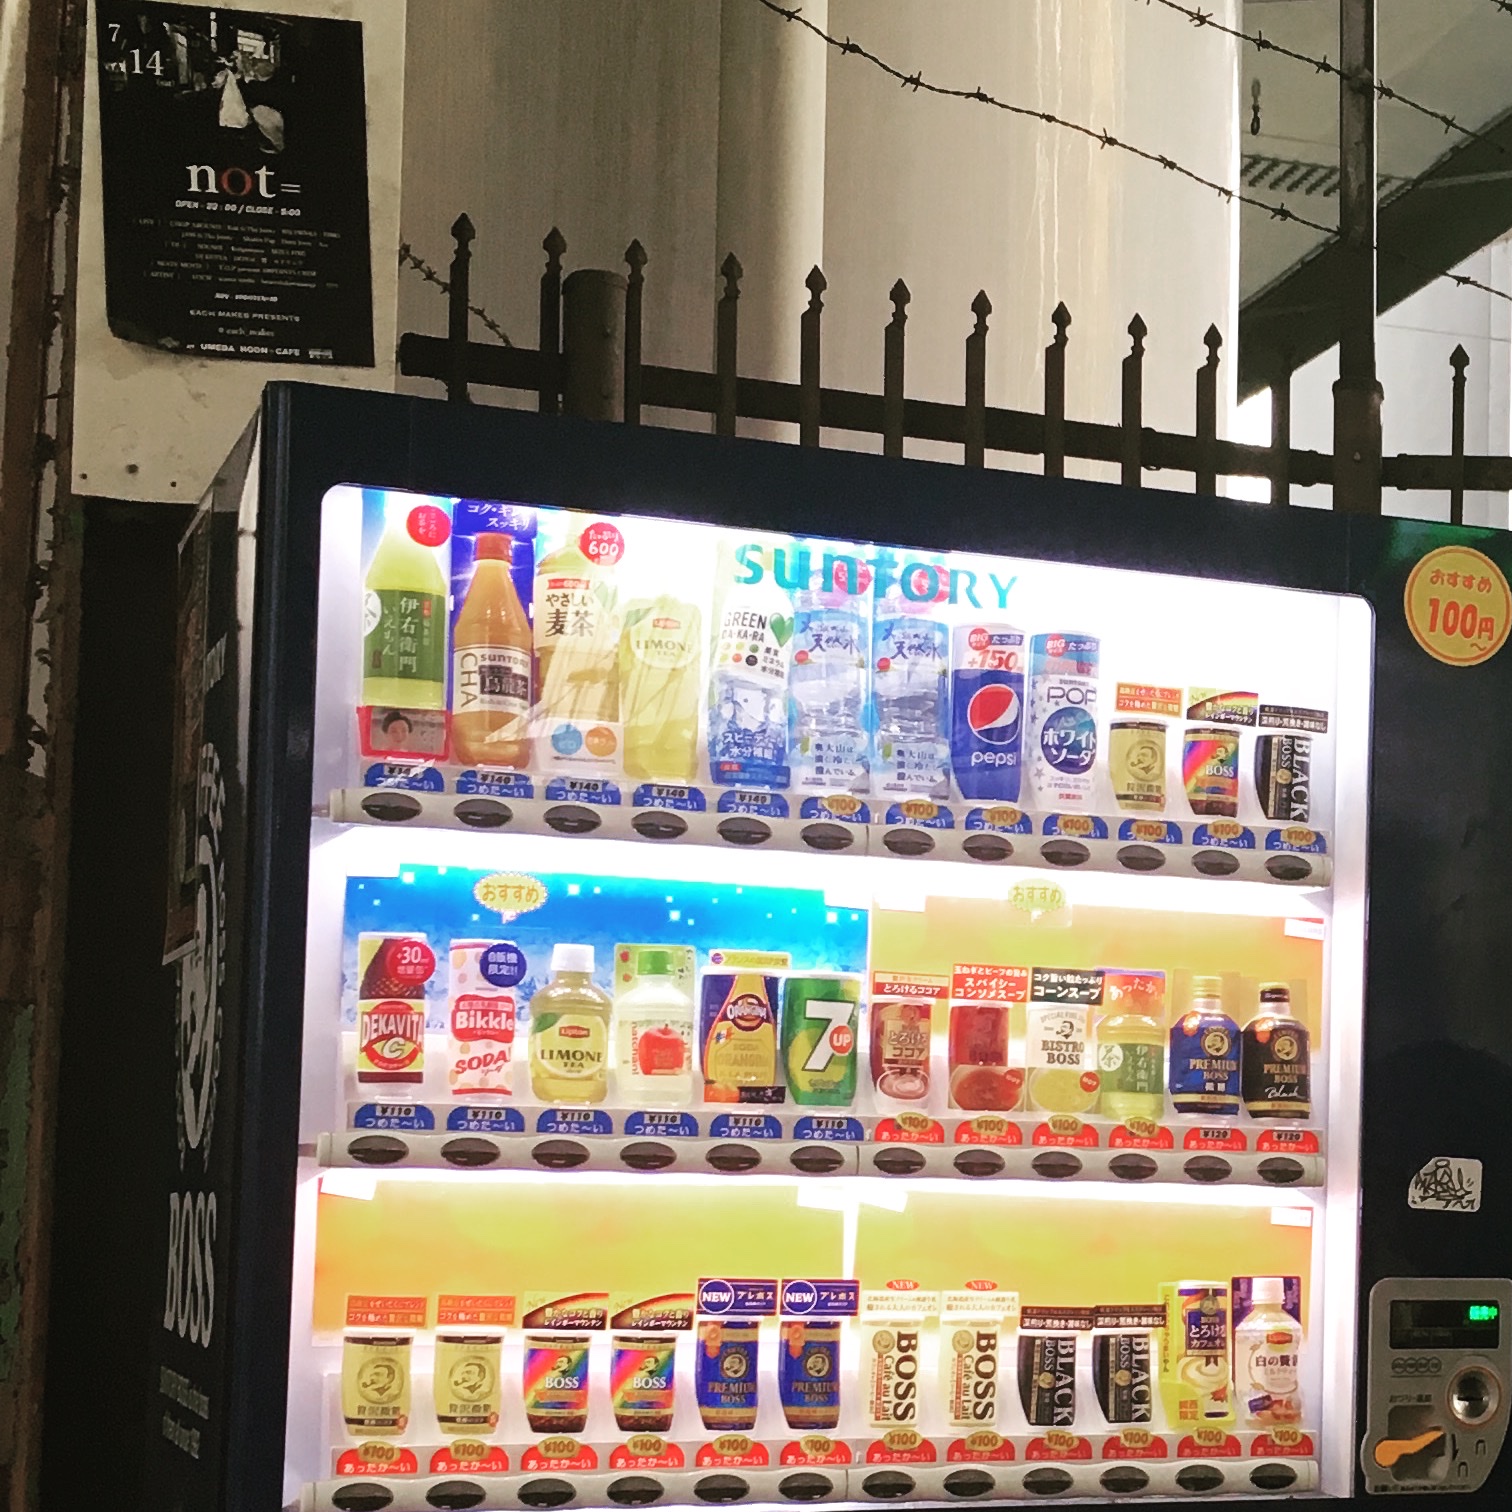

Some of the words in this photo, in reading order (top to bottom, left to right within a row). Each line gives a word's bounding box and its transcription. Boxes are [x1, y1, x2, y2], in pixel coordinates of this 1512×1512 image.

[130, 48, 164, 76] 14
[587, 541, 620, 557] 600
[734, 543, 1019, 610] SUNTORY
[1430, 568, 1493, 594] おすすめ
[545, 609, 595, 638] 麦茶
[399, 596, 420, 674] 伊右衛門
[459, 653, 479, 709] CHA
[1043, 727, 1097, 747] ホワイト
[970, 750, 1017, 767] pepsi
[1204, 763, 1235, 777] BOSS
[1289, 733, 1311, 822] BLACK
[482, 883, 540, 904] おすすめ
[883, 983, 942, 996] とろけるココア
[964, 977, 1016, 988] スパイシー
[954, 987, 1026, 1000] コンソメスープ
[1033, 985, 1101, 1000] コーンスープ
[455, 1010, 515, 1032] Bikkle
[801, 999, 855, 1073] 7
[831, 1032, 853, 1048] UP
[1040, 1039, 1084, 1054] BISTRO
[539, 1047, 604, 1064] LIMONE
[1046, 1051, 1081, 1065] BOSS
[891, 1279, 915, 1291] NEW
[970, 1279, 994, 1291] NEW
[701, 1290, 732, 1303] NEW
[784, 1291, 815, 1304] NEW
[1188, 1323, 1225, 1339] とろける
[544, 1376, 580, 1390] BOSS
[632, 1376, 667, 1390] BOSS
[892, 1330, 918, 1422] BOSS
[972, 1330, 998, 1422] BOSS
[1052, 1336, 1076, 1427] BLACK
[1129, 1335, 1152, 1425] BLACK
[720, 1392, 747, 1404] BOSS
[804, 1392, 830, 1404] BOSS
